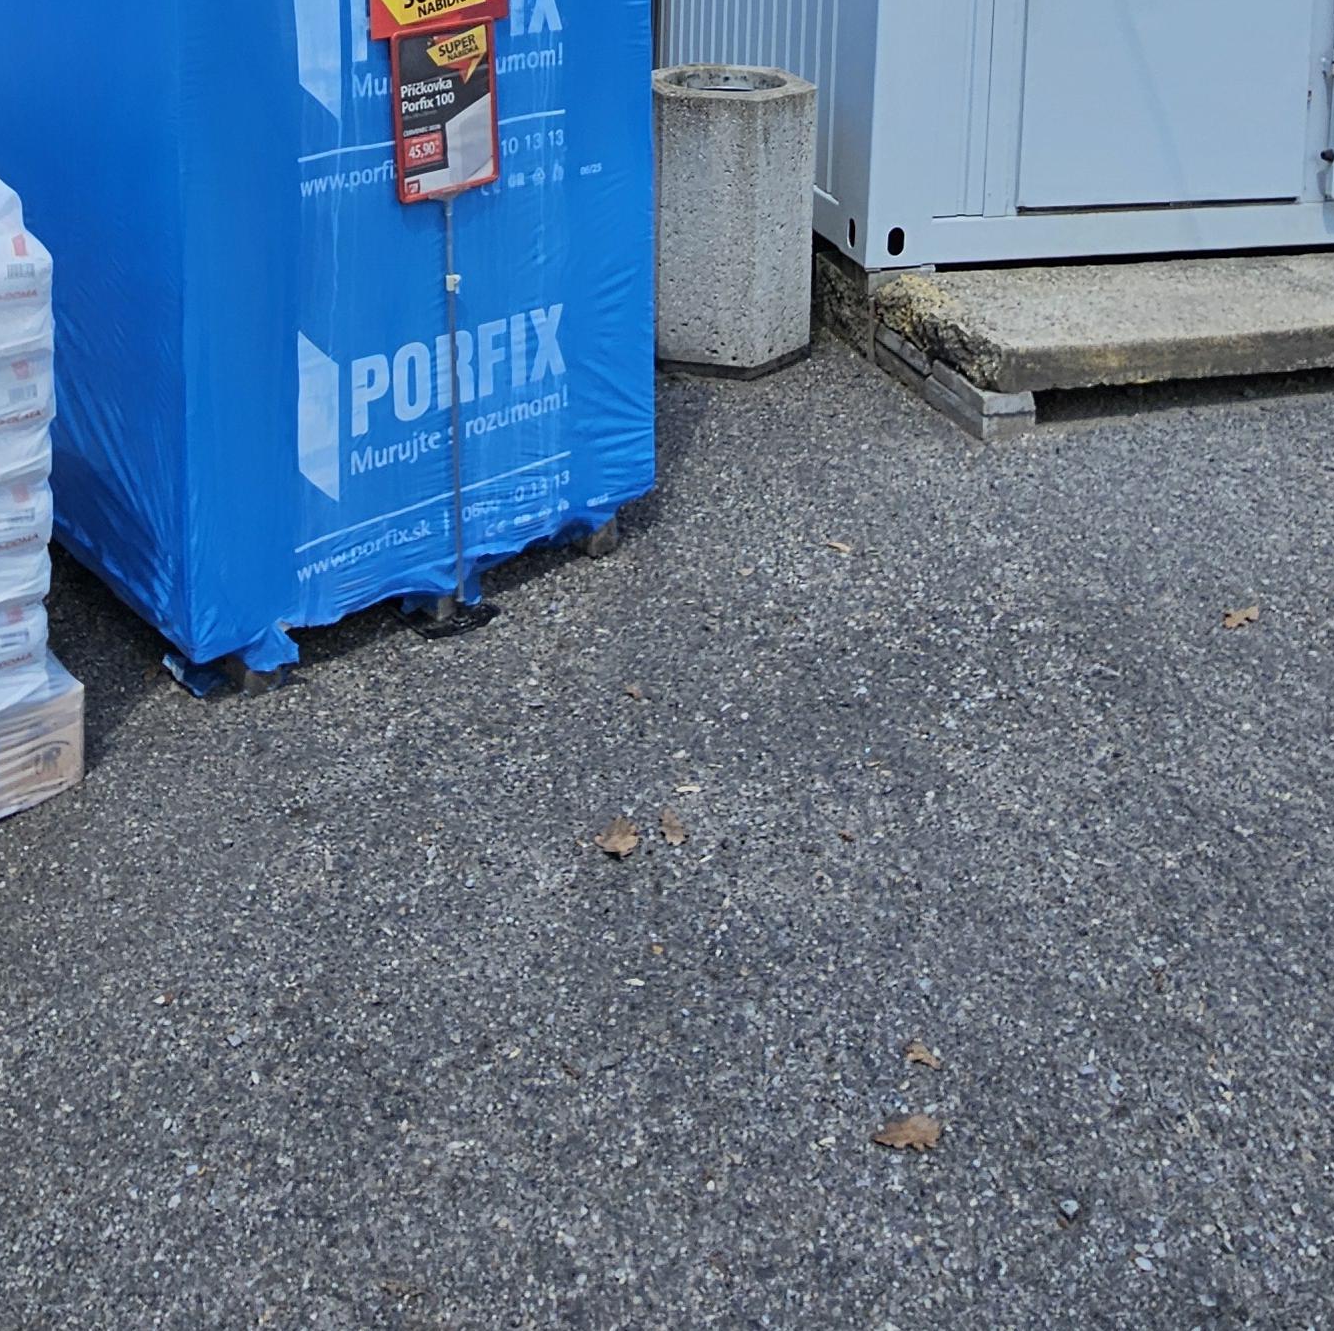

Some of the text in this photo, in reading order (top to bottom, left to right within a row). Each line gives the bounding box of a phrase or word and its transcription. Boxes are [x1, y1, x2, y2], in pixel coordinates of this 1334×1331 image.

[438, 33, 476, 58] SUPER
[495, 42, 563, 75] umom!
[400, 78, 453, 99] Příčkovka
[401, 92, 455, 114] Porfix 100
[408, 141, 435, 159] 45,90
[501, 129, 564, 157] 10 13 13
[300, 159, 395, 198] www.porfi
[351, 302, 566, 438] PORFIX
[350, 430, 443, 476] Murujte
[465, 383, 568, 440] rozumom!
[296, 519, 432, 583] www.porfix.sk
[554, 469, 570, 488] 13
